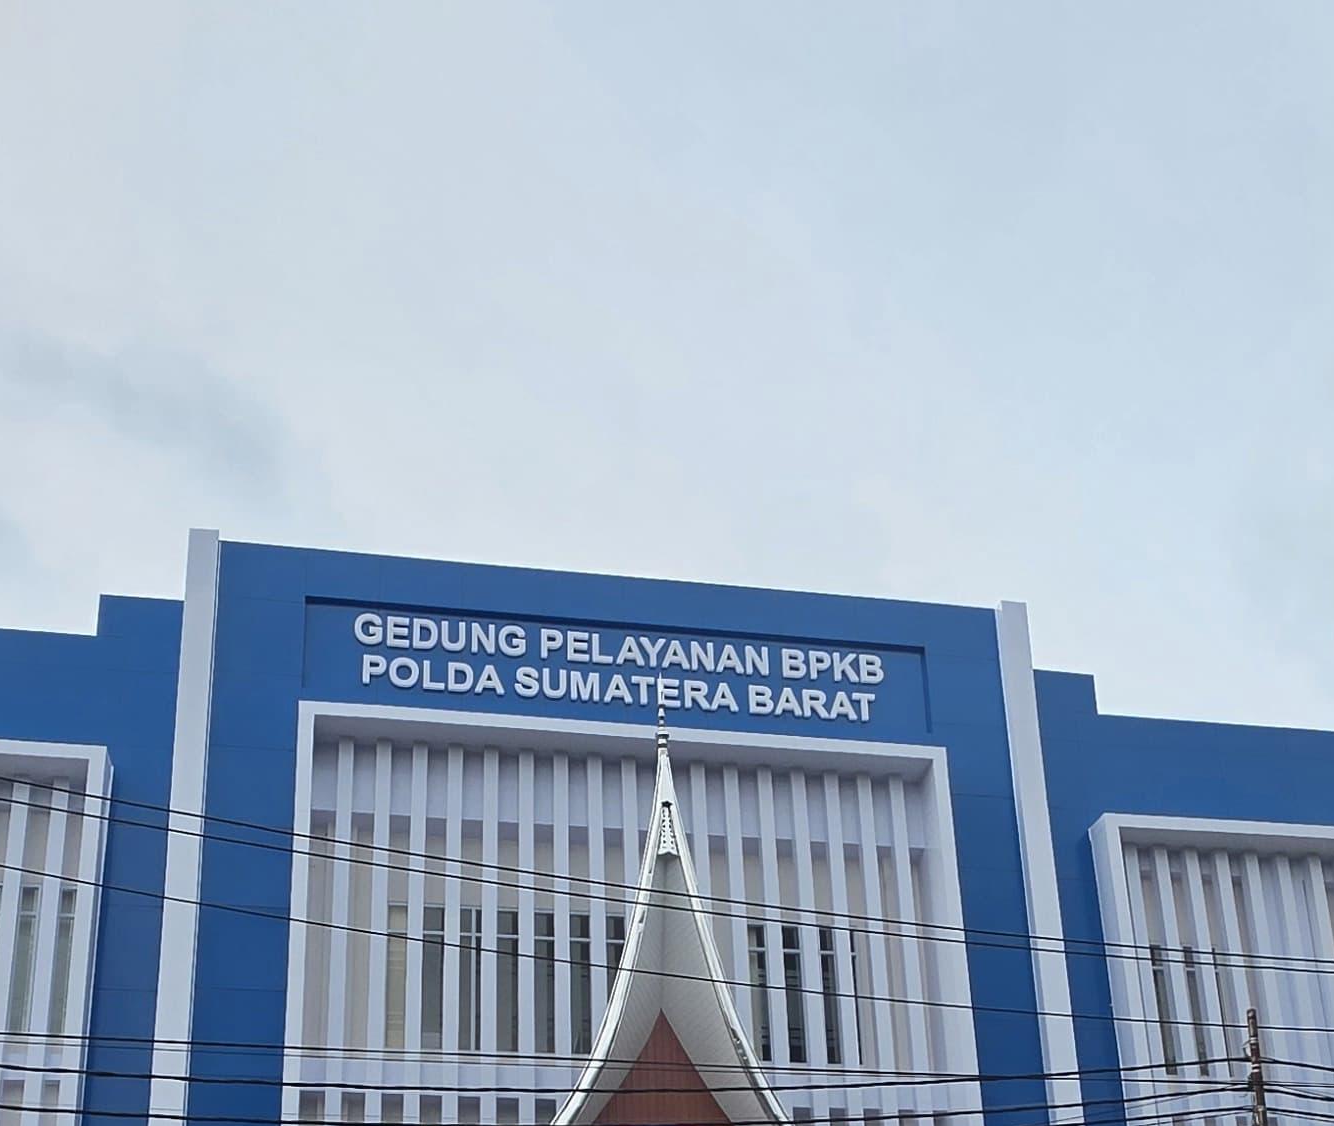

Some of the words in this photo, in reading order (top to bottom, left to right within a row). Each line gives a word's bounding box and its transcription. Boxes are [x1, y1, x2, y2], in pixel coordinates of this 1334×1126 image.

[354, 612, 527, 658] GEDUNG
[539, 628, 770, 676] PELAYANAN
[781, 648, 885, 685] BPKB
[362, 654, 505, 696] POLDA
[514, 667, 740, 713] SUMATERA
[747, 684, 876, 721] BARAT
